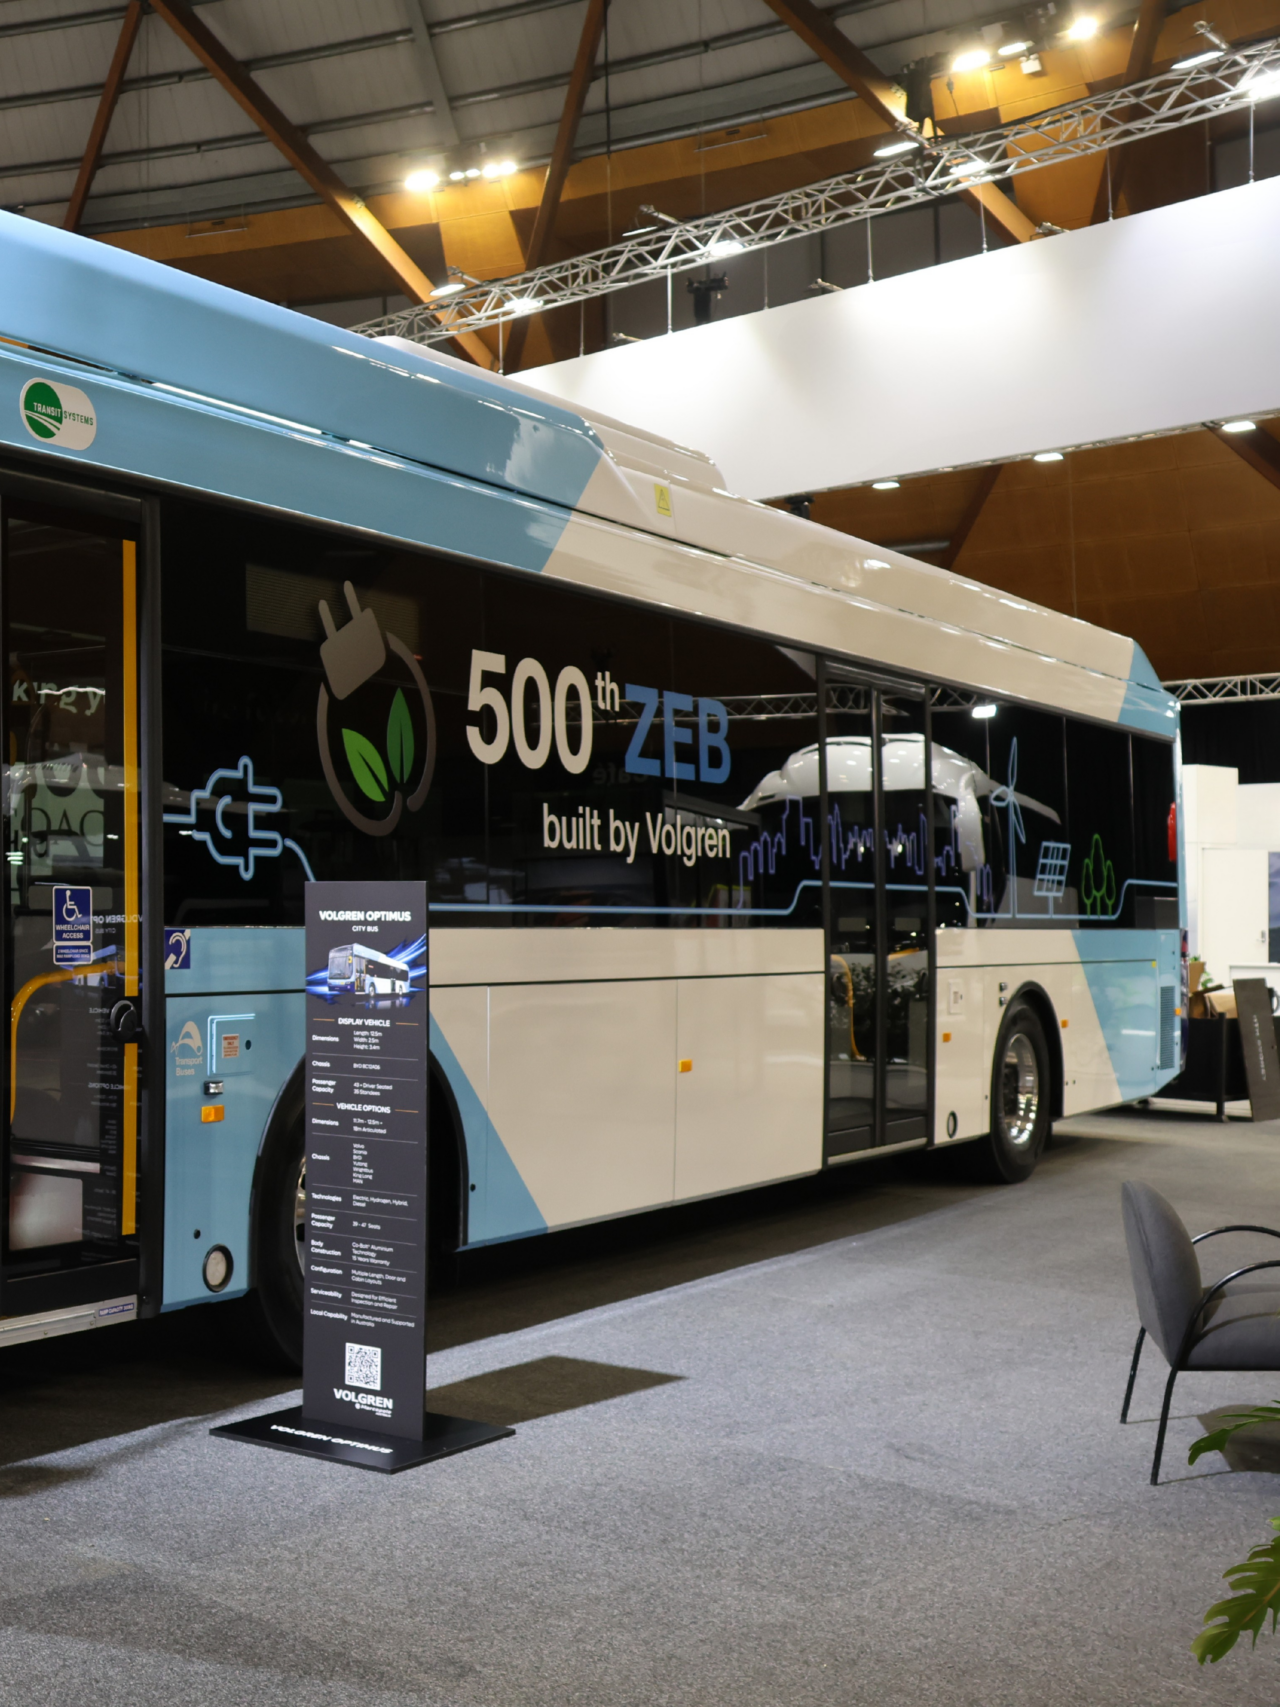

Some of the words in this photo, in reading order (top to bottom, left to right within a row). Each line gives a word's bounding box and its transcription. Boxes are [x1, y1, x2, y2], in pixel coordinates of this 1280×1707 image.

[33, 402, 62, 418] TRANSIT
[63, 410, 94, 426] SYSTEMS
[625, 683, 731, 785] ZEB
[543, 802, 601, 851] built
[609, 808, 640, 865] by
[645, 812, 731, 867] Volgren
[319, 910, 365, 921] VOLGREN
[366, 911, 412, 921] OPTIMUS
[338, 1017, 363, 1025] DISPLAY
[364, 1019, 390, 1027] VEHICLE
[312, 1034, 339, 1042] Dimensions
[175, 1056, 203, 1066] Transport
[175, 1067, 195, 1076] Buses
[312, 1078, 336, 1086] Passenger
[336, 1102, 362, 1111] VEHICLE
[363, 1104, 391, 1114] OPTIONS
[312, 1117, 339, 1126] Dimensions
[311, 1192, 342, 1202] Technologies
[311, 1212, 335, 1221] Passenger
[311, 1220, 333, 1229] Capacity
[311, 1239, 324, 1247] Body
[311, 1247, 341, 1256] Construction
[310, 1264, 343, 1274] Configuration
[310, 1287, 342, 1298] Serviceability
[310, 1308, 323, 1316] Local
[323, 1310, 348, 1321] Capability
[351, 1312, 381, 1322] Manufactured
[391, 1319, 415, 1328] Supported
[356, 1319, 375, 1328] Australia
[333, 1388, 393, 1409] VOLGREN
[271, 1424, 332, 1442] VOLGREN
[331, 1438, 393, 1454] OPTIMUS
